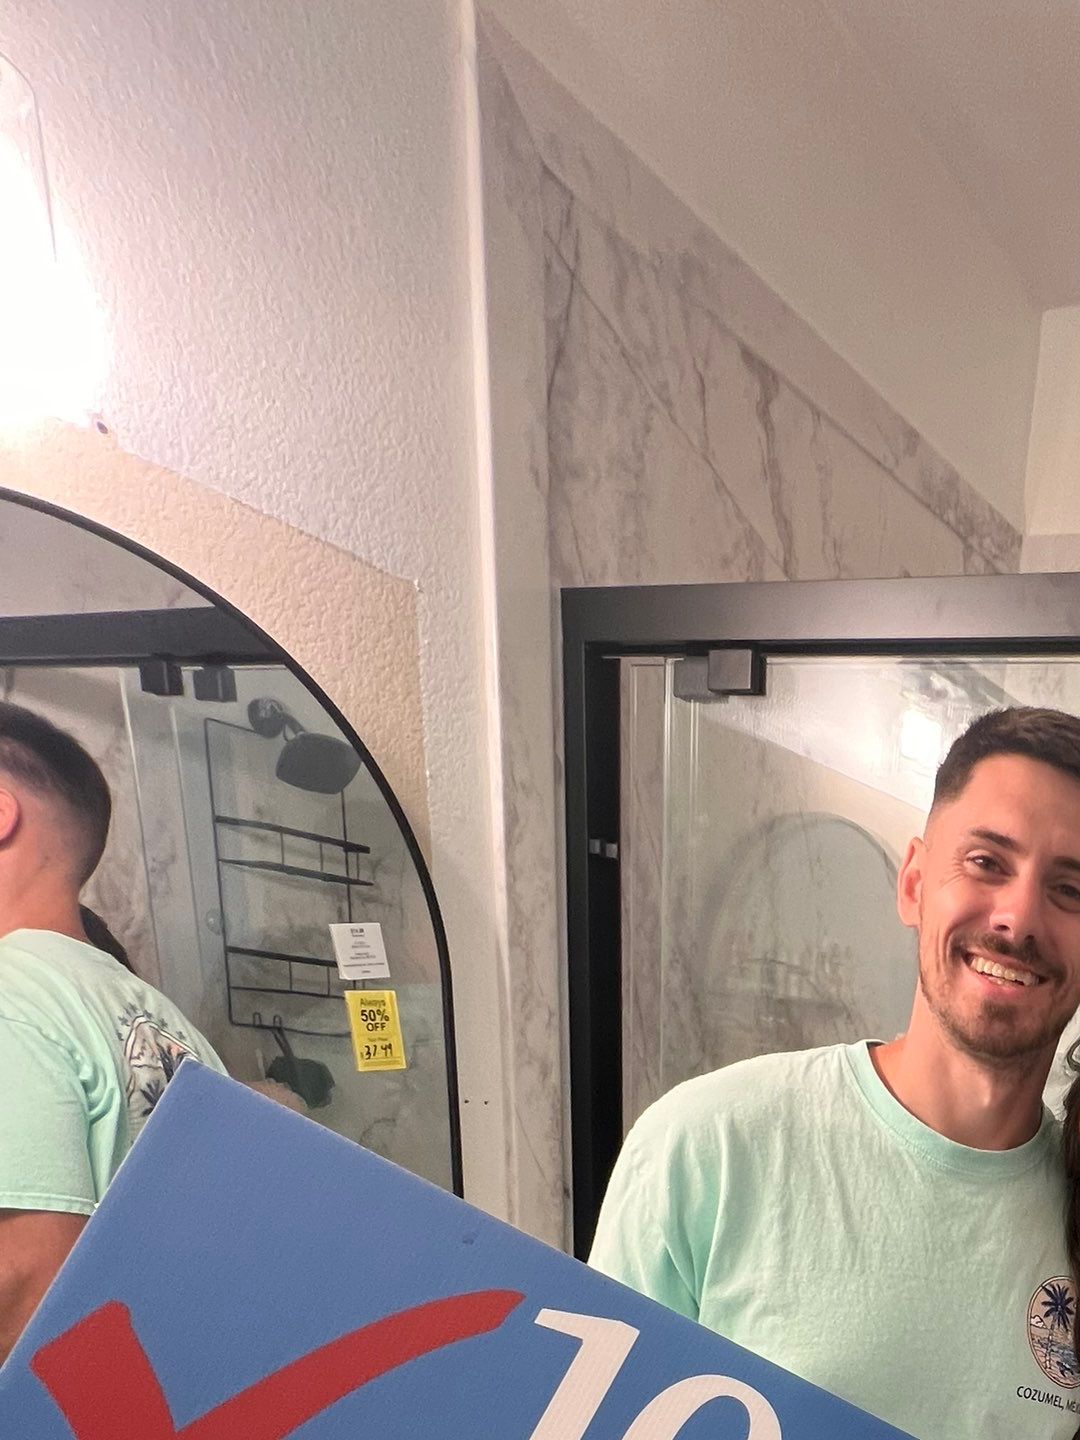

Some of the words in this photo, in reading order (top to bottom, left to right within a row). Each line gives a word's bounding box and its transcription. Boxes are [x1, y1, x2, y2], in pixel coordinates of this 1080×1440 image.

[360, 1009, 390, 1022] 50%
[366, 1022, 386, 1032] OFF
[1016, 1386, 1064, 1411] COZUMEL,
